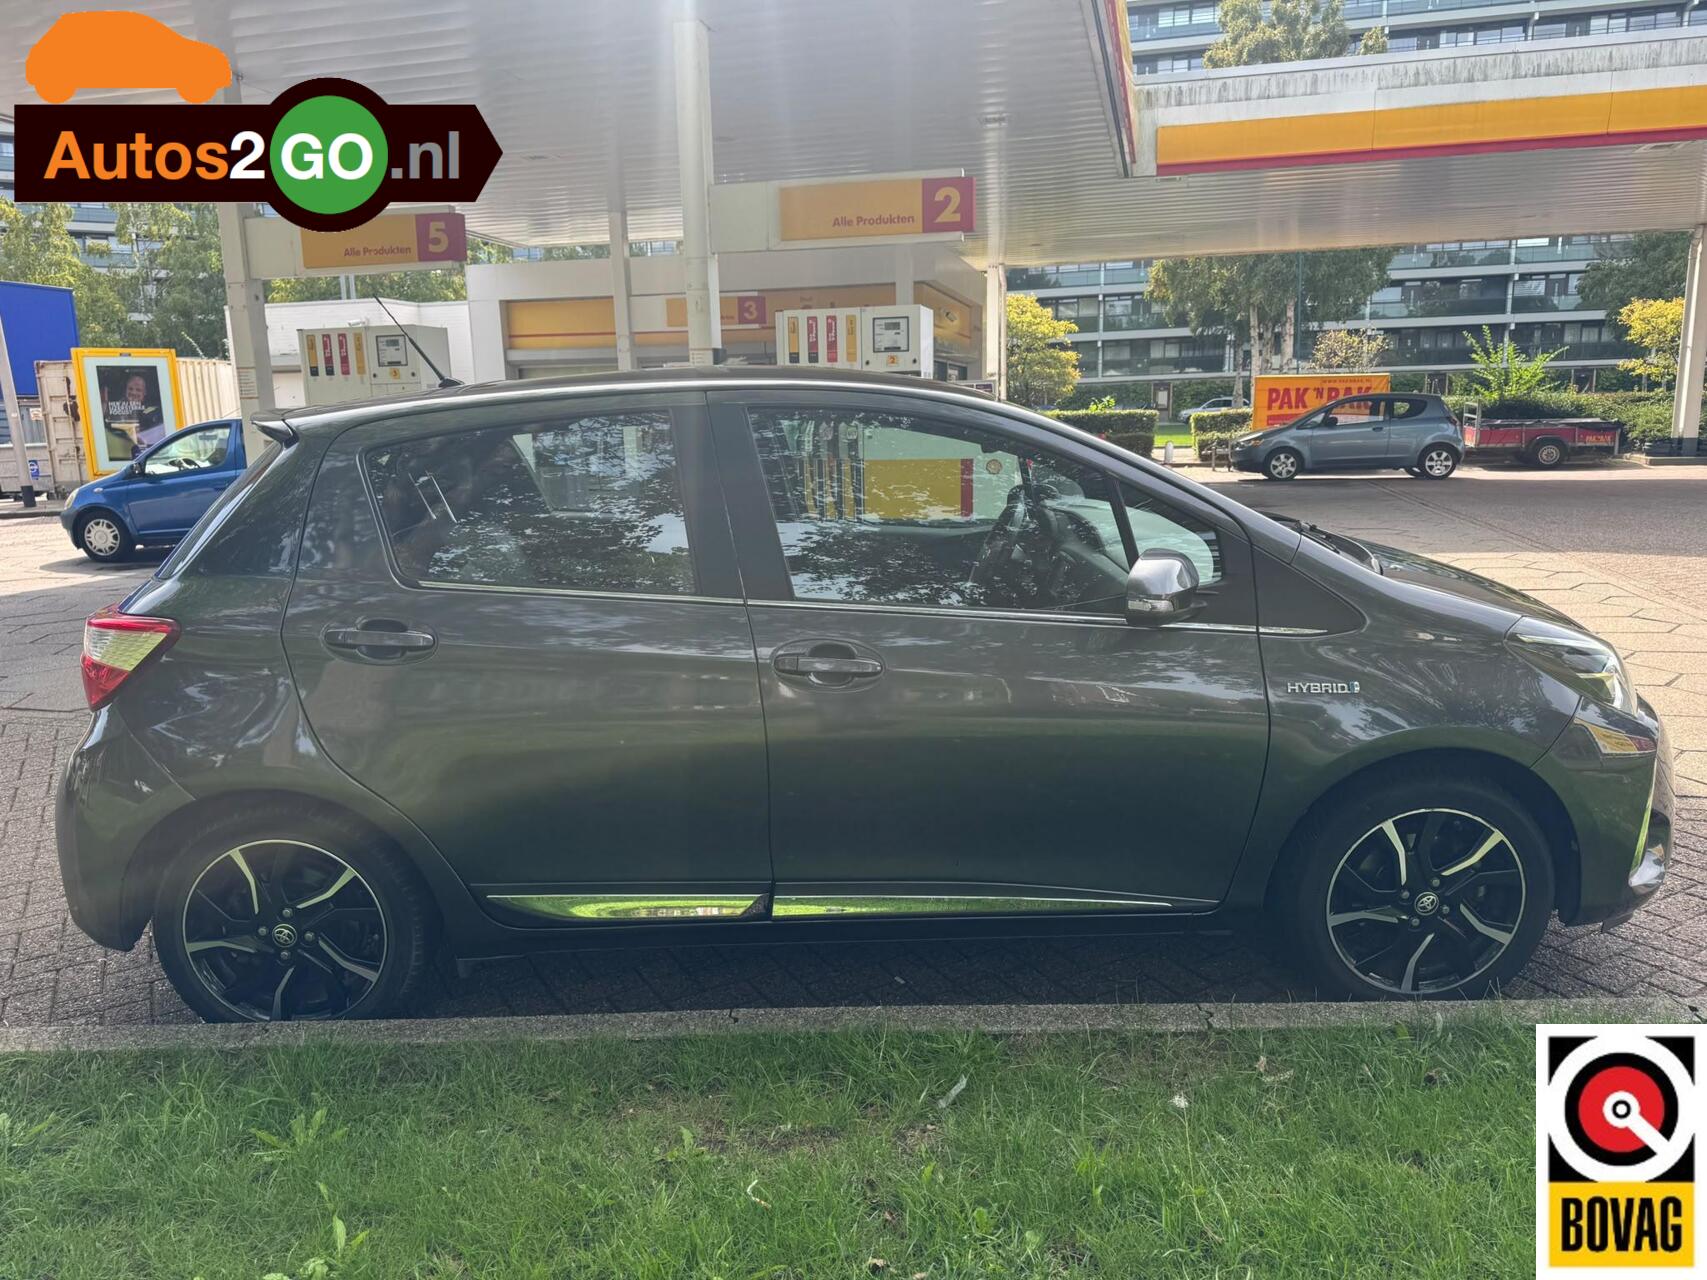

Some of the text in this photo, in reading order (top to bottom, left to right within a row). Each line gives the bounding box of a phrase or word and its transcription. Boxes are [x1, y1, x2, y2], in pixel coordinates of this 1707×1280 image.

[933, 186, 961, 223] 2
[832, 214, 914, 228] Alle Produkten
[428, 221, 449, 253] 5
[344, 245, 412, 257] Alle Produkten
[743, 301, 758, 320] 3
[1267, 387, 1310, 411] PAK
[1287, 682, 1349, 694] HYBRID
